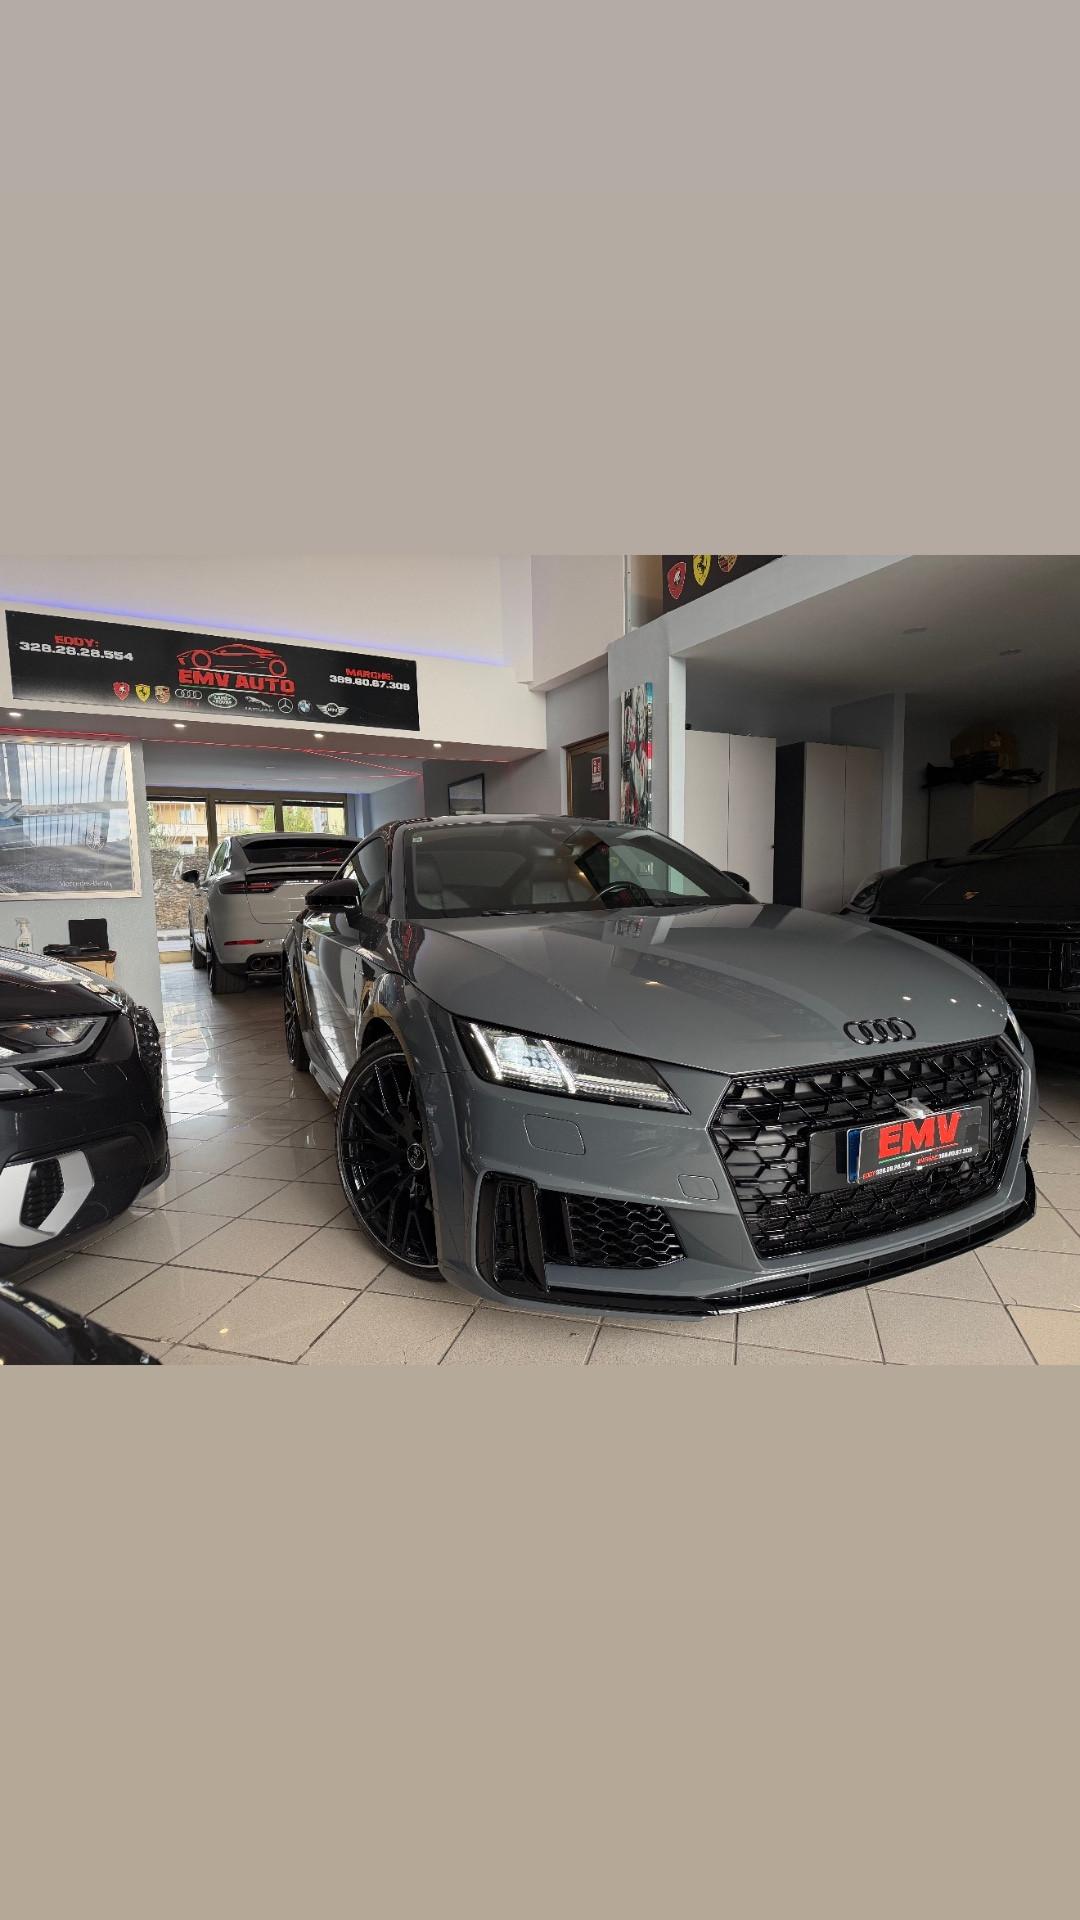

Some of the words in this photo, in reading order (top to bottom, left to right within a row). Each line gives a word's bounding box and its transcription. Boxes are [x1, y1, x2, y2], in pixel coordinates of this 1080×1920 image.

[19, 641, 134, 661] 328.28.28.554
[54, 635, 100, 648] EDDY:
[178, 669, 230, 688] EMV
[235, 674, 296, 695] AUTO
[878, 1111, 962, 1159] EMV
